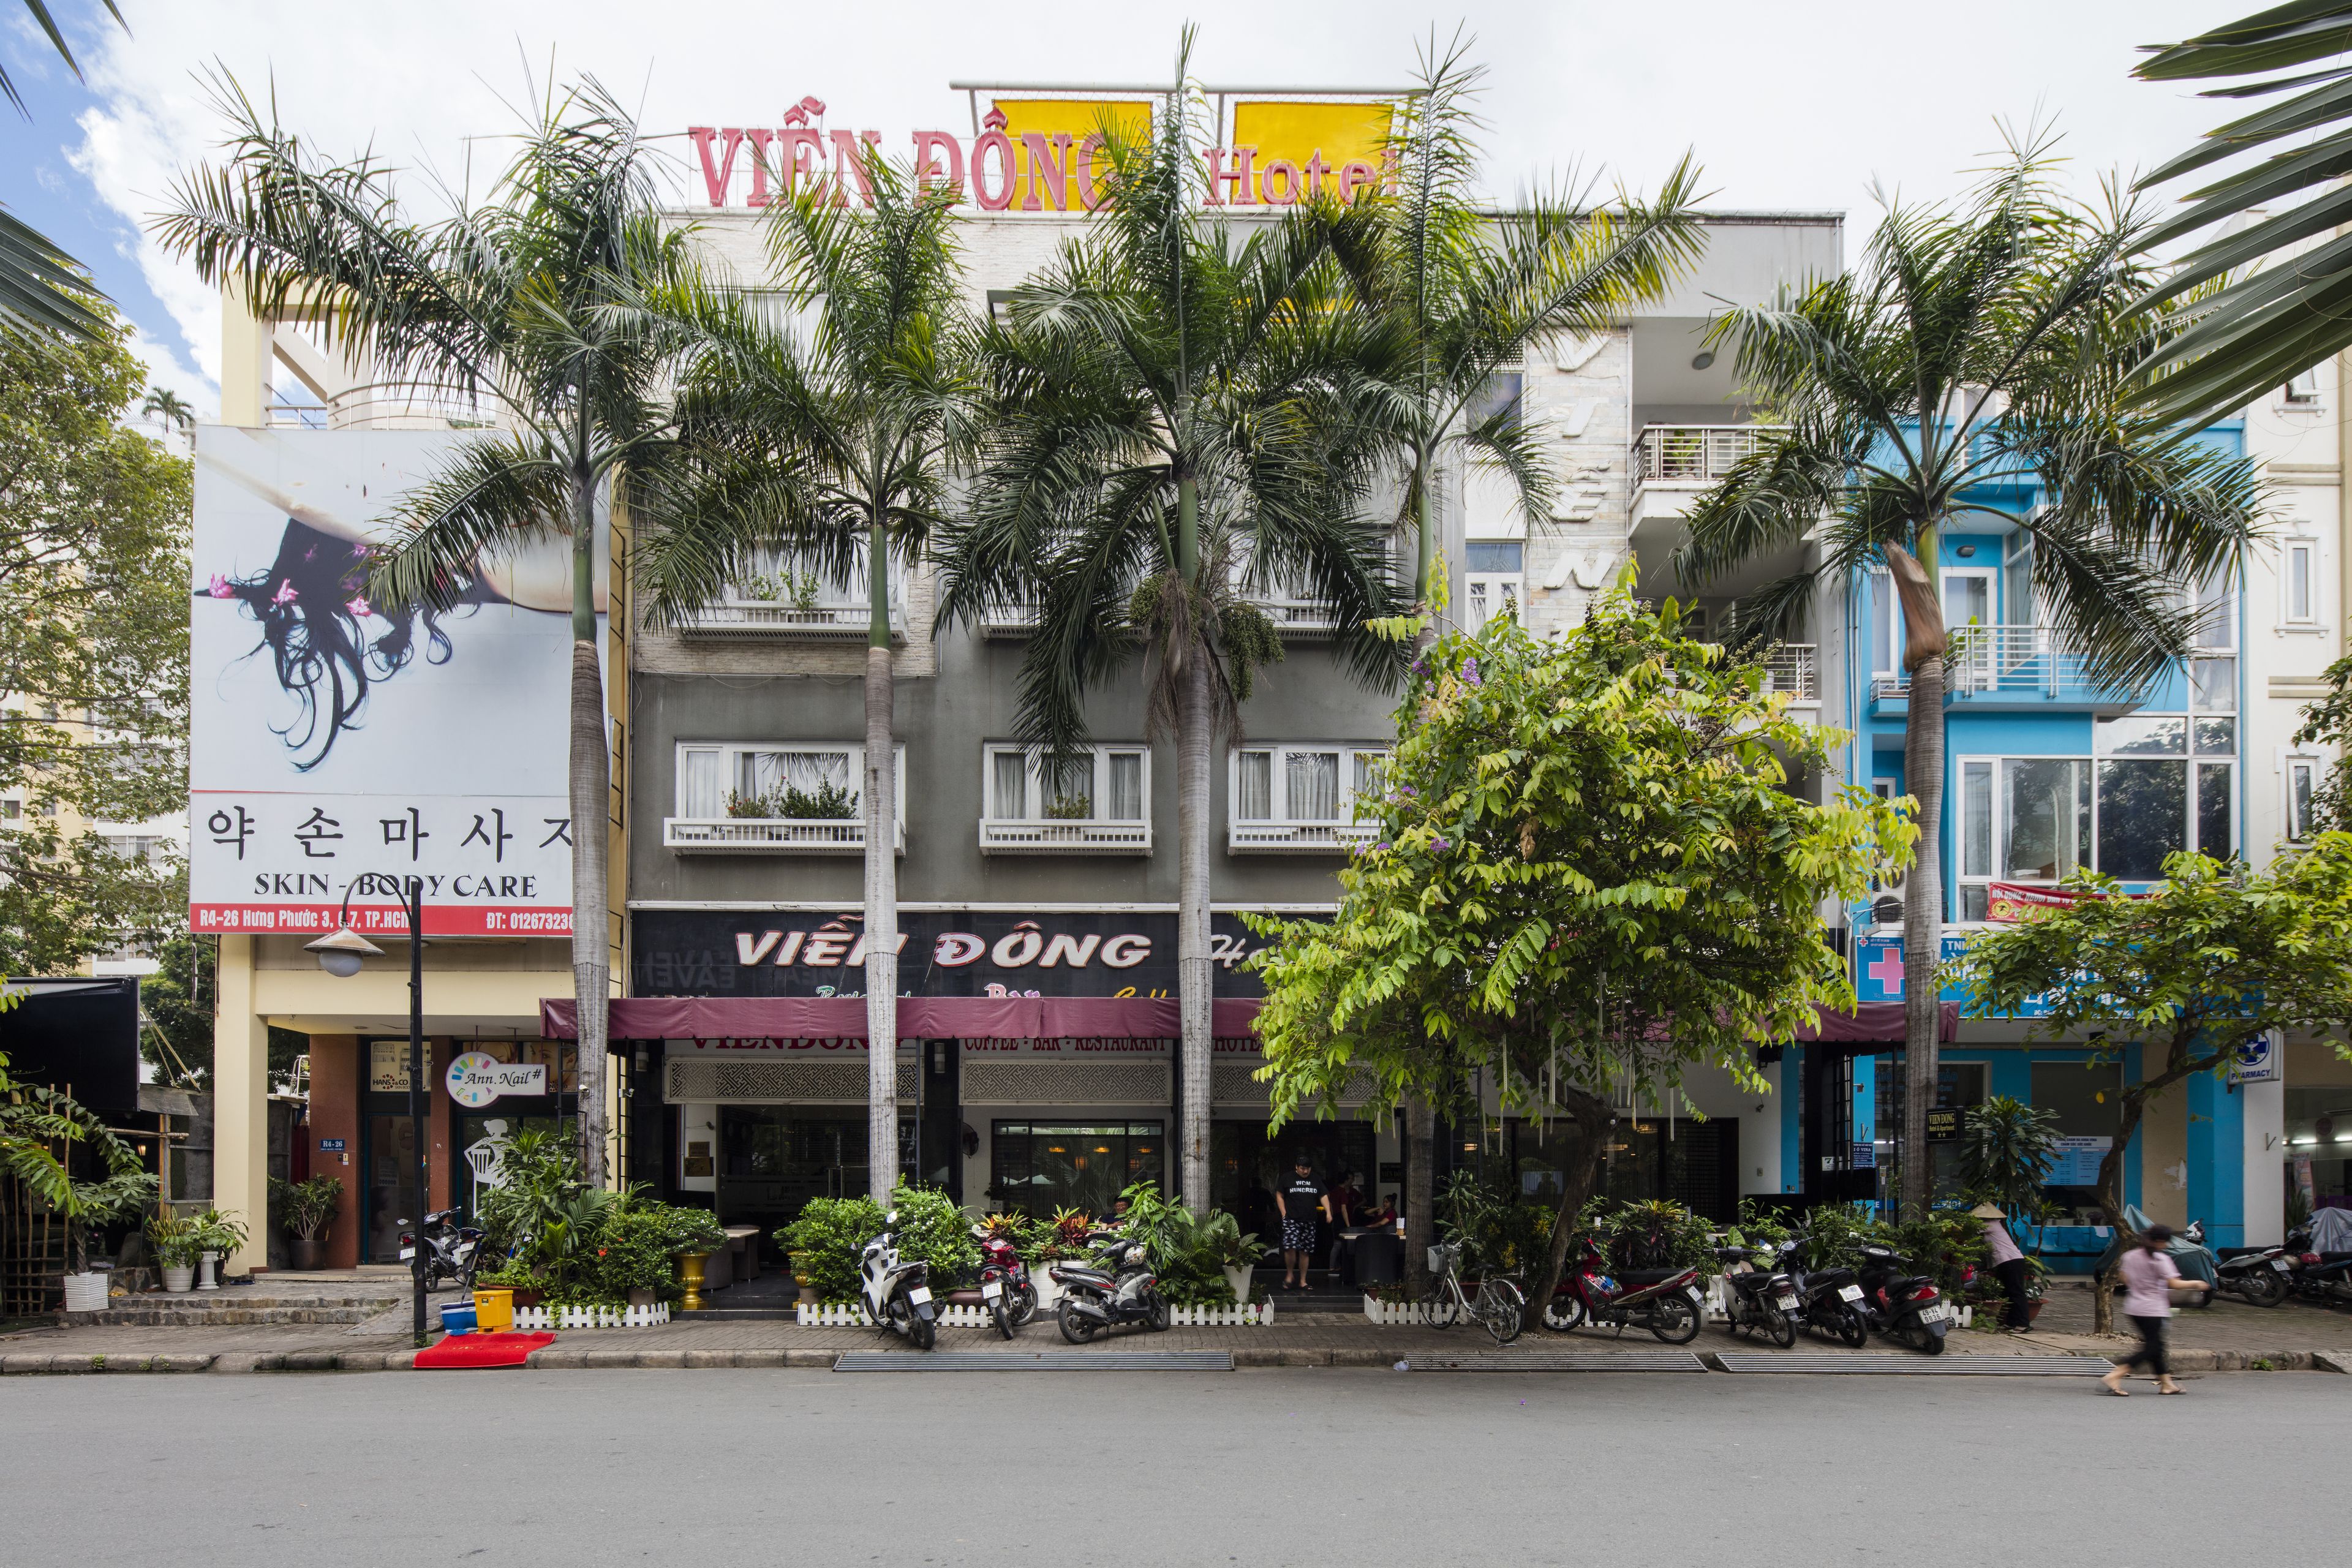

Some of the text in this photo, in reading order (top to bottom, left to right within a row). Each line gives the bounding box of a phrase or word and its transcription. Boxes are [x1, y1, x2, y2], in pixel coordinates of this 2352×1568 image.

[254, 873, 329, 895] SKIN
[356, 874, 446, 897] BODY
[452, 874, 537, 899] CARE
[200, 910, 239, 927] R4-26
[243, 910, 274, 928] Hưng
[279, 909, 318, 927] Phước
[322, 911, 333, 929] 3,
[486, 912, 506, 929] ĐT:
[935, 920, 1152, 968] ĐÔNG
